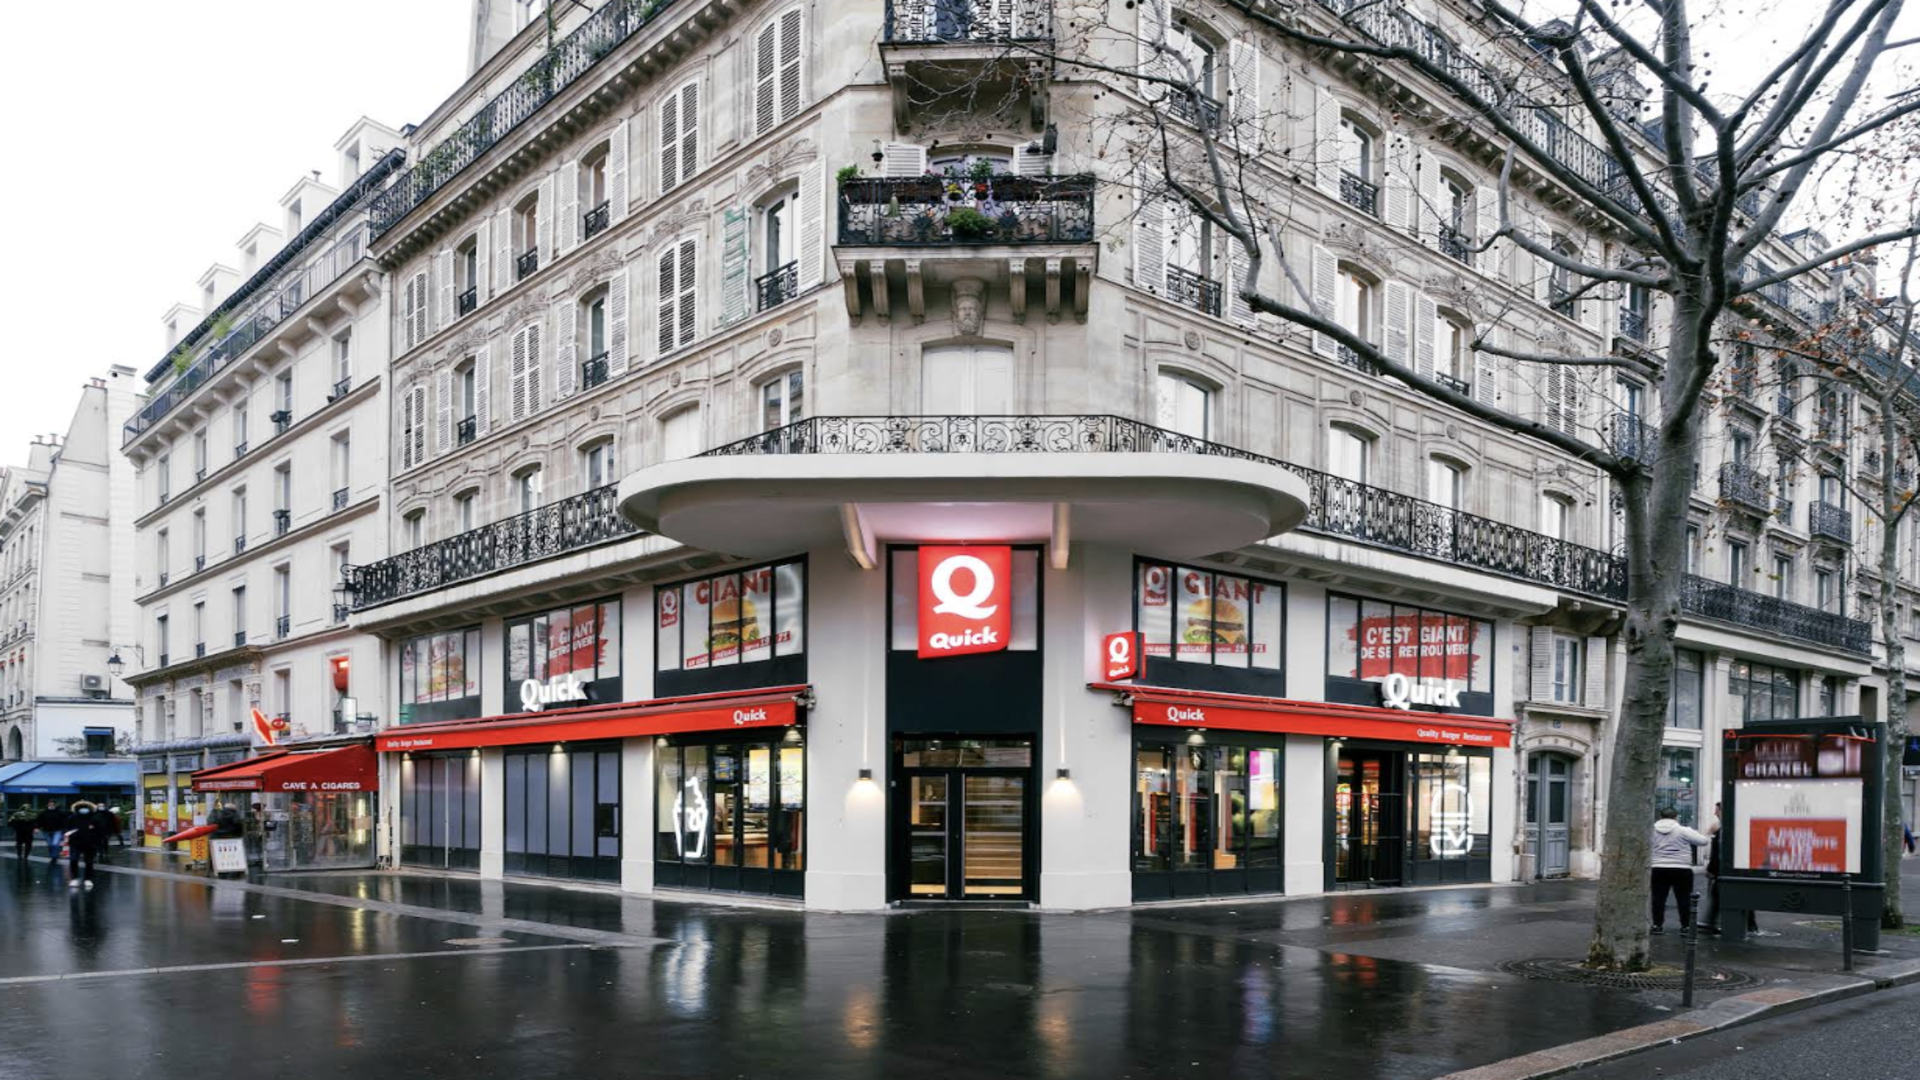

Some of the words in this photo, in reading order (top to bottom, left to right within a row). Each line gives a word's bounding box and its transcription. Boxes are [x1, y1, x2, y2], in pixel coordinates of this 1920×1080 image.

[696, 570, 772, 605] GIANT
[931, 554, 998, 619] Q
[1184, 572, 1265, 604] GIANT
[560, 620, 595, 645] GIANT
[929, 625, 998, 649] Quick
[1366, 626, 1412, 645] C'EST
[1421, 625, 1464, 643] GIANT
[1109, 636, 1130, 663] Q
[1361, 646, 1376, 660] DE
[1378, 645, 1392, 659] SE
[1108, 665, 1130, 677] Quick
[521, 674, 588, 712] Quick
[1381, 673, 1461, 711] Quick
[733, 708, 767, 725] Quick
[1167, 706, 1205, 722] Quick
[1417, 728, 1439, 740] Quality
[1442, 730, 1461, 741] Burger
[1744, 761, 1813, 778] CHANEL
[282, 782, 307, 790] CAVE
[321, 782, 361, 790] CIGARES
